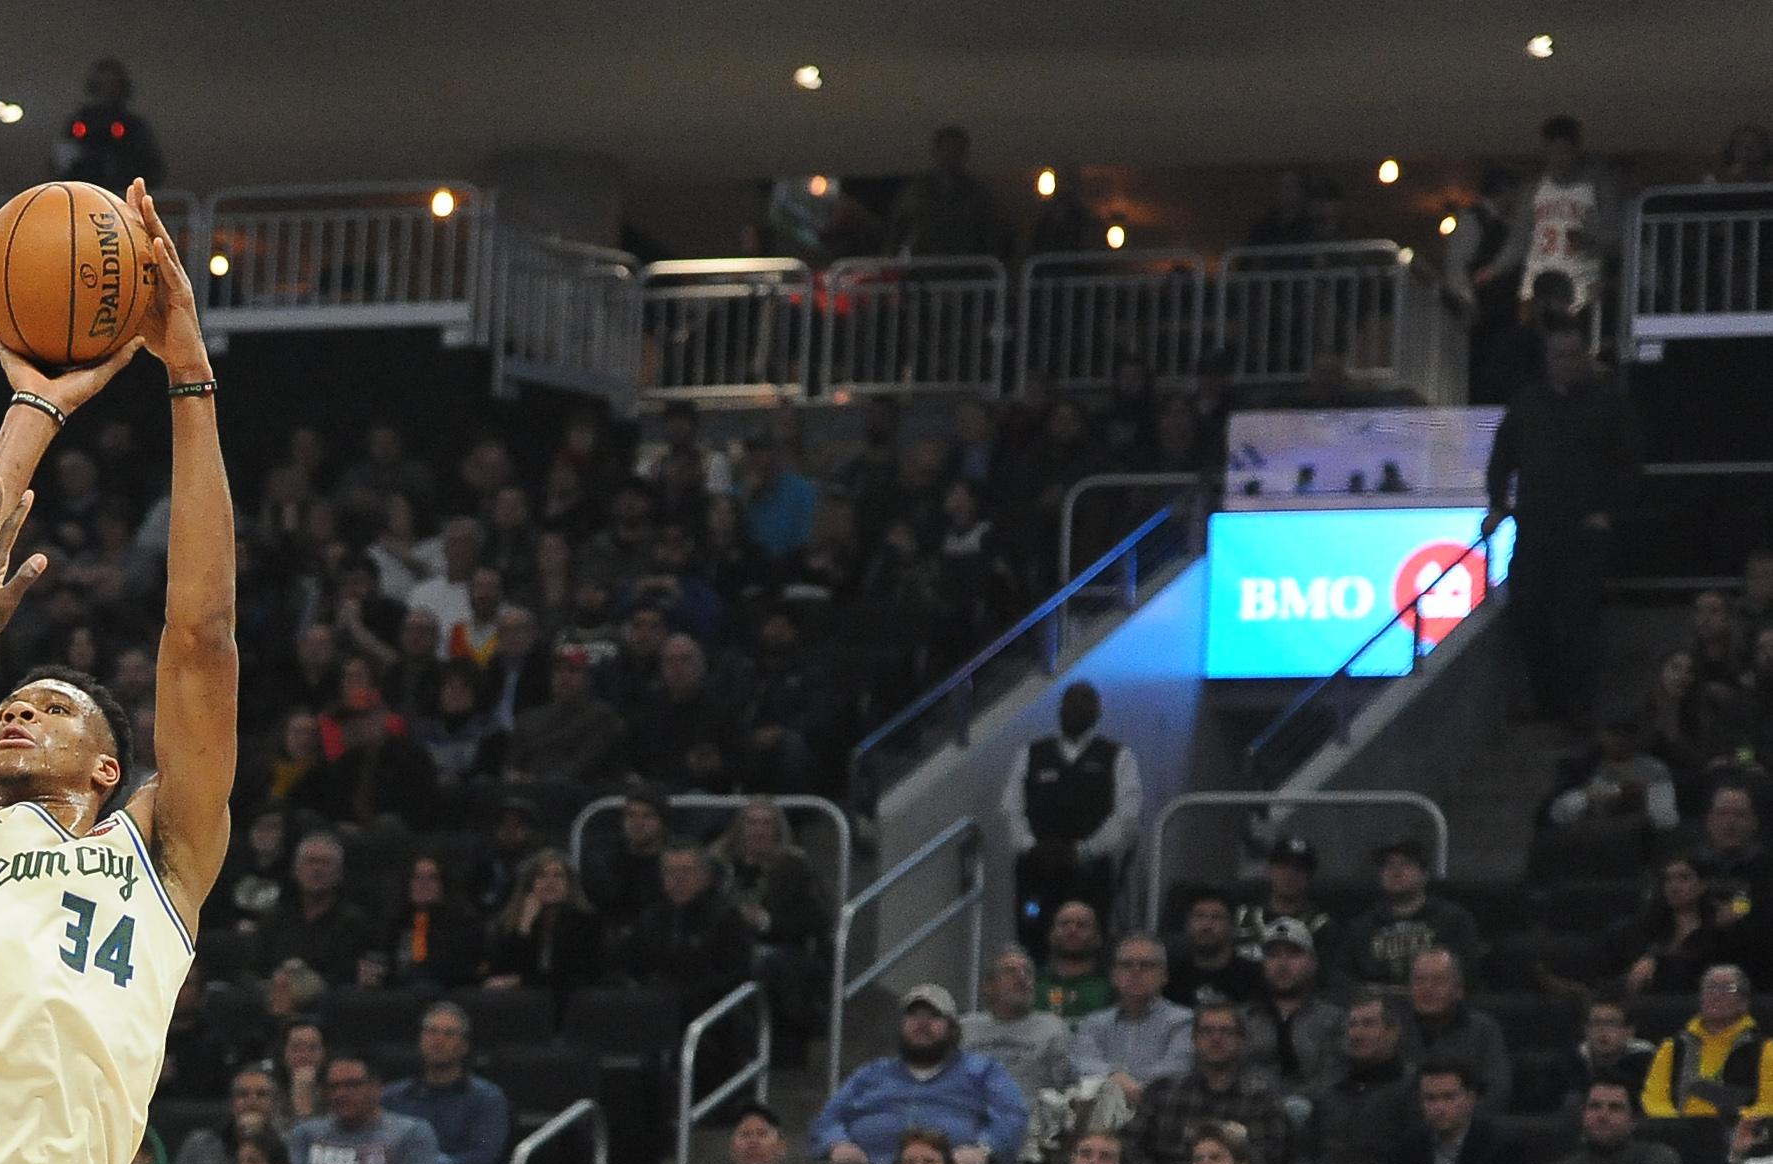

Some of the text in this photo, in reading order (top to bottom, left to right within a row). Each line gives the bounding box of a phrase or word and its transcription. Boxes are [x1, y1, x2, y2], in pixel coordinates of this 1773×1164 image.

[88, 211, 121, 339] SPALDING
[1238, 575, 1375, 621] BMO
[76, 846, 139, 902] City
[59, 890, 136, 988] 34
